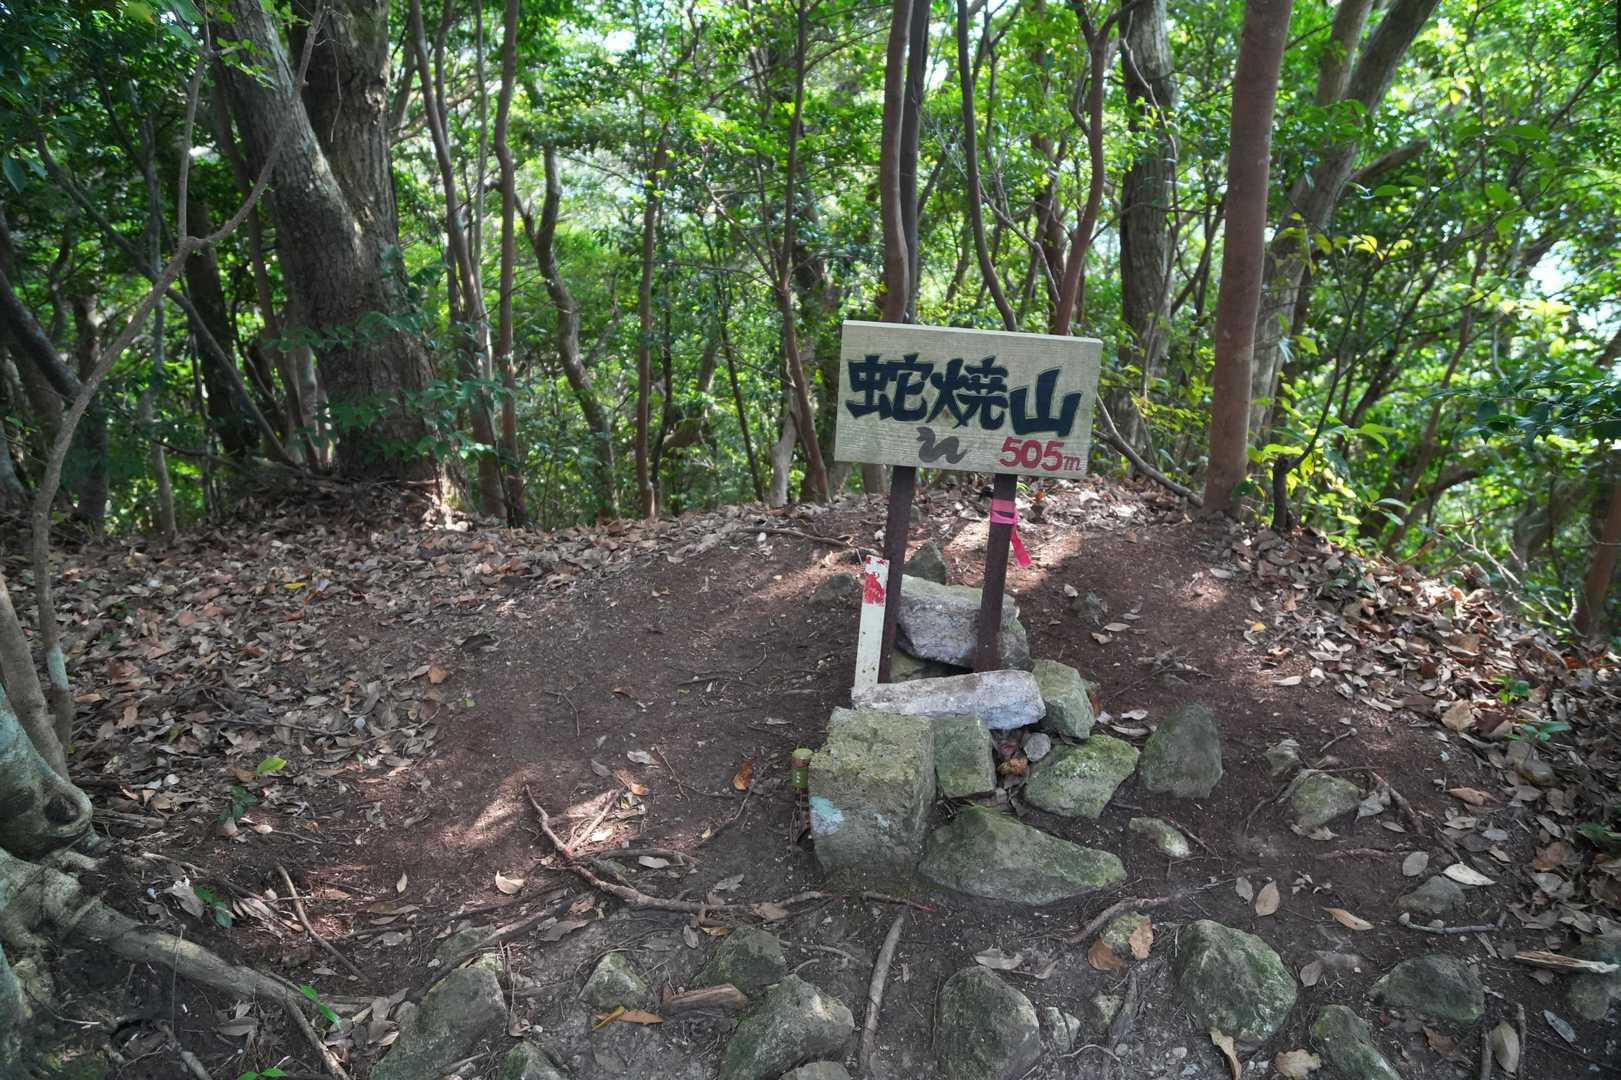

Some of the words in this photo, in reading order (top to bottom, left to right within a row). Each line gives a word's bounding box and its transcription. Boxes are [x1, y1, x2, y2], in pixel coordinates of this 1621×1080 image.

[846, 352, 1082, 436] 蛇焼山
[999, 437, 1082, 472] 505m
